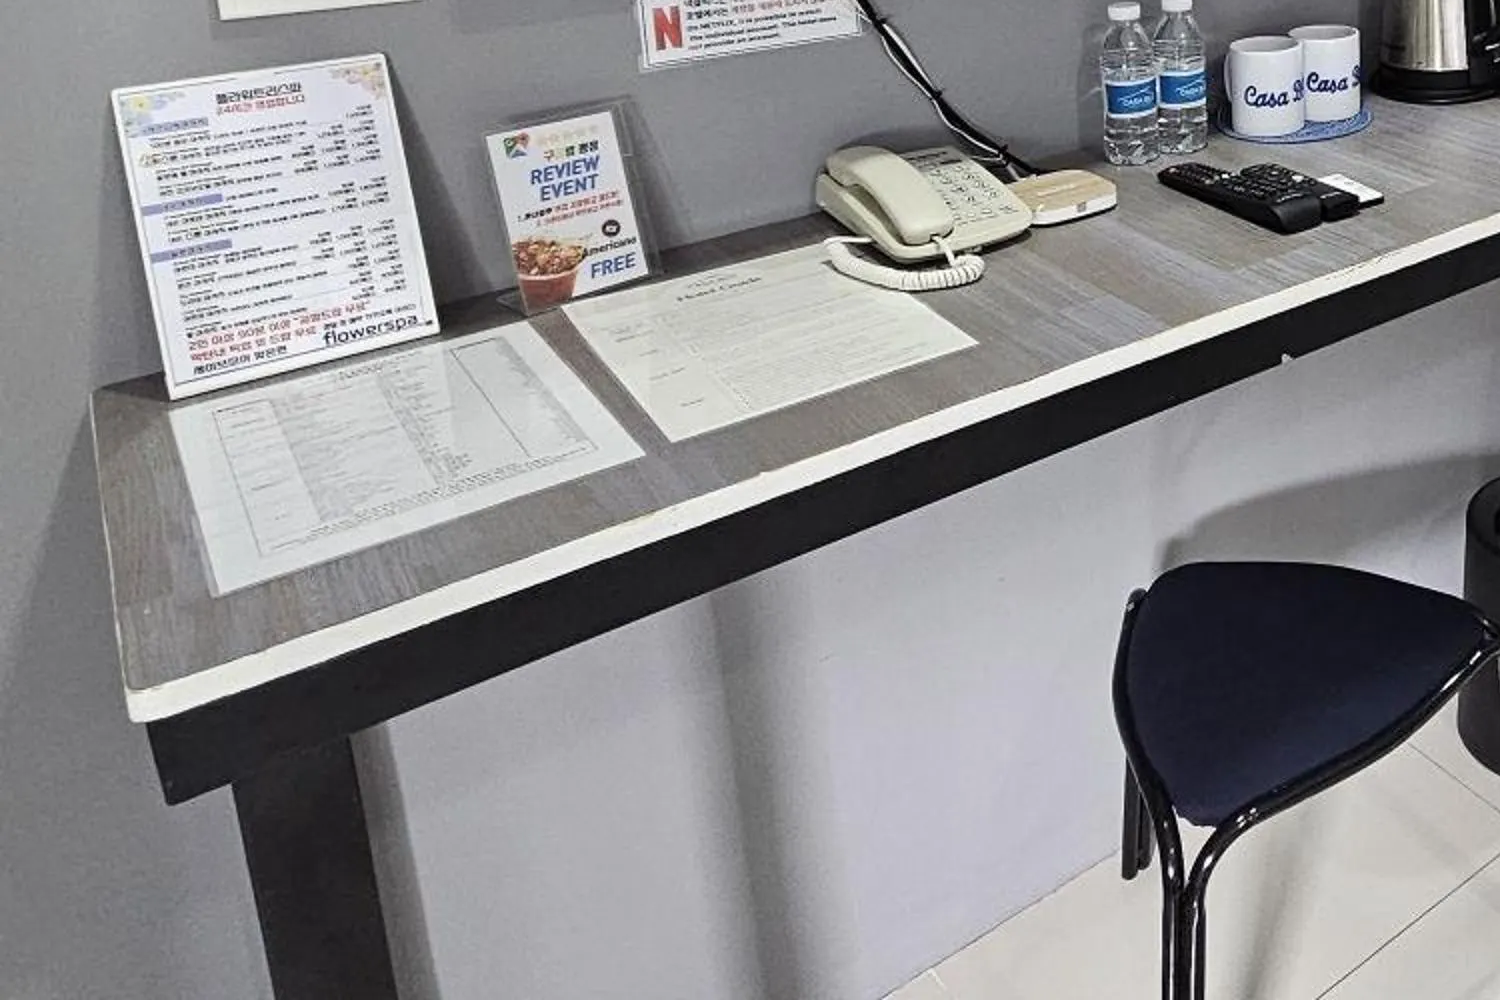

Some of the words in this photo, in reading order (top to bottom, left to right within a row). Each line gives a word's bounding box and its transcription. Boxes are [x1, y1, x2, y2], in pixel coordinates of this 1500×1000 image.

[1305, 71, 1348, 93] Casa
[1244, 85, 1289, 108] Casa
[530, 154, 600, 185] REVIEW
[540, 173, 599, 202] EVENT
[590, 251, 637, 279] FREE
[322, 311, 419, 346] flowerspa
